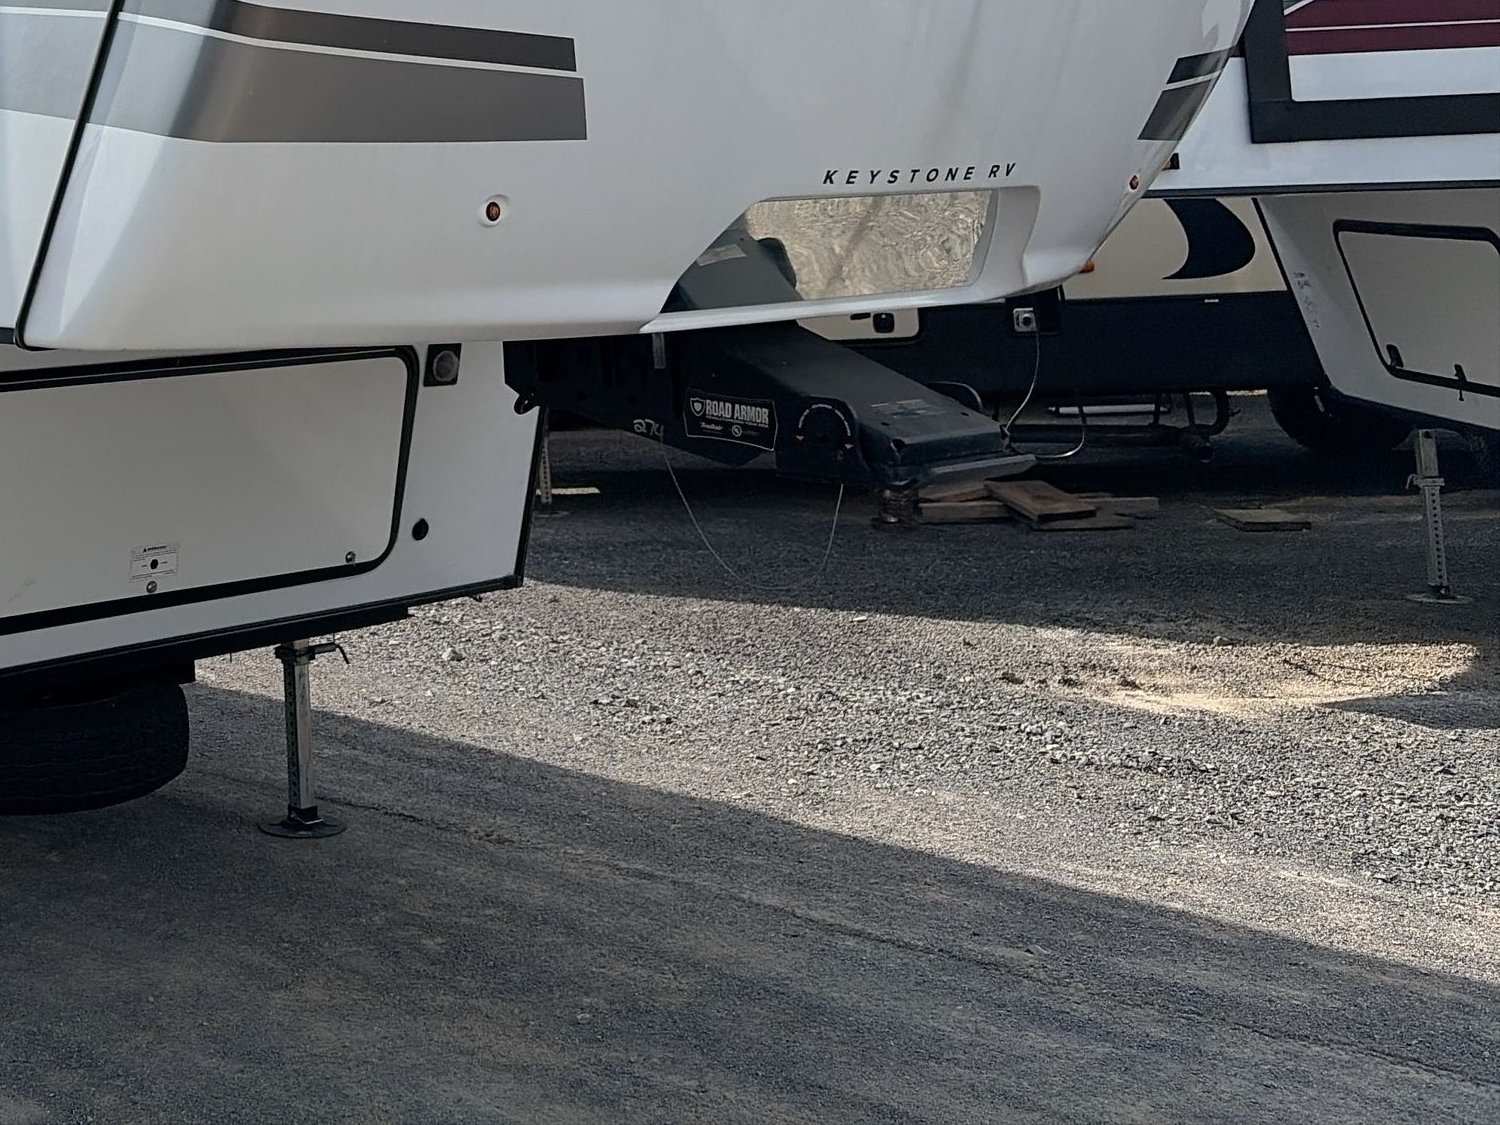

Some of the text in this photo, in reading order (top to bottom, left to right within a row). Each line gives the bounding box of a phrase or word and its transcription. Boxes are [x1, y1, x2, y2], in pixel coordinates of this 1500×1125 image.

[822, 162, 1016, 185] KEYSTONE RV
[705, 399, 732, 418] ROAD
[733, 403, 769, 424] ARMOR
